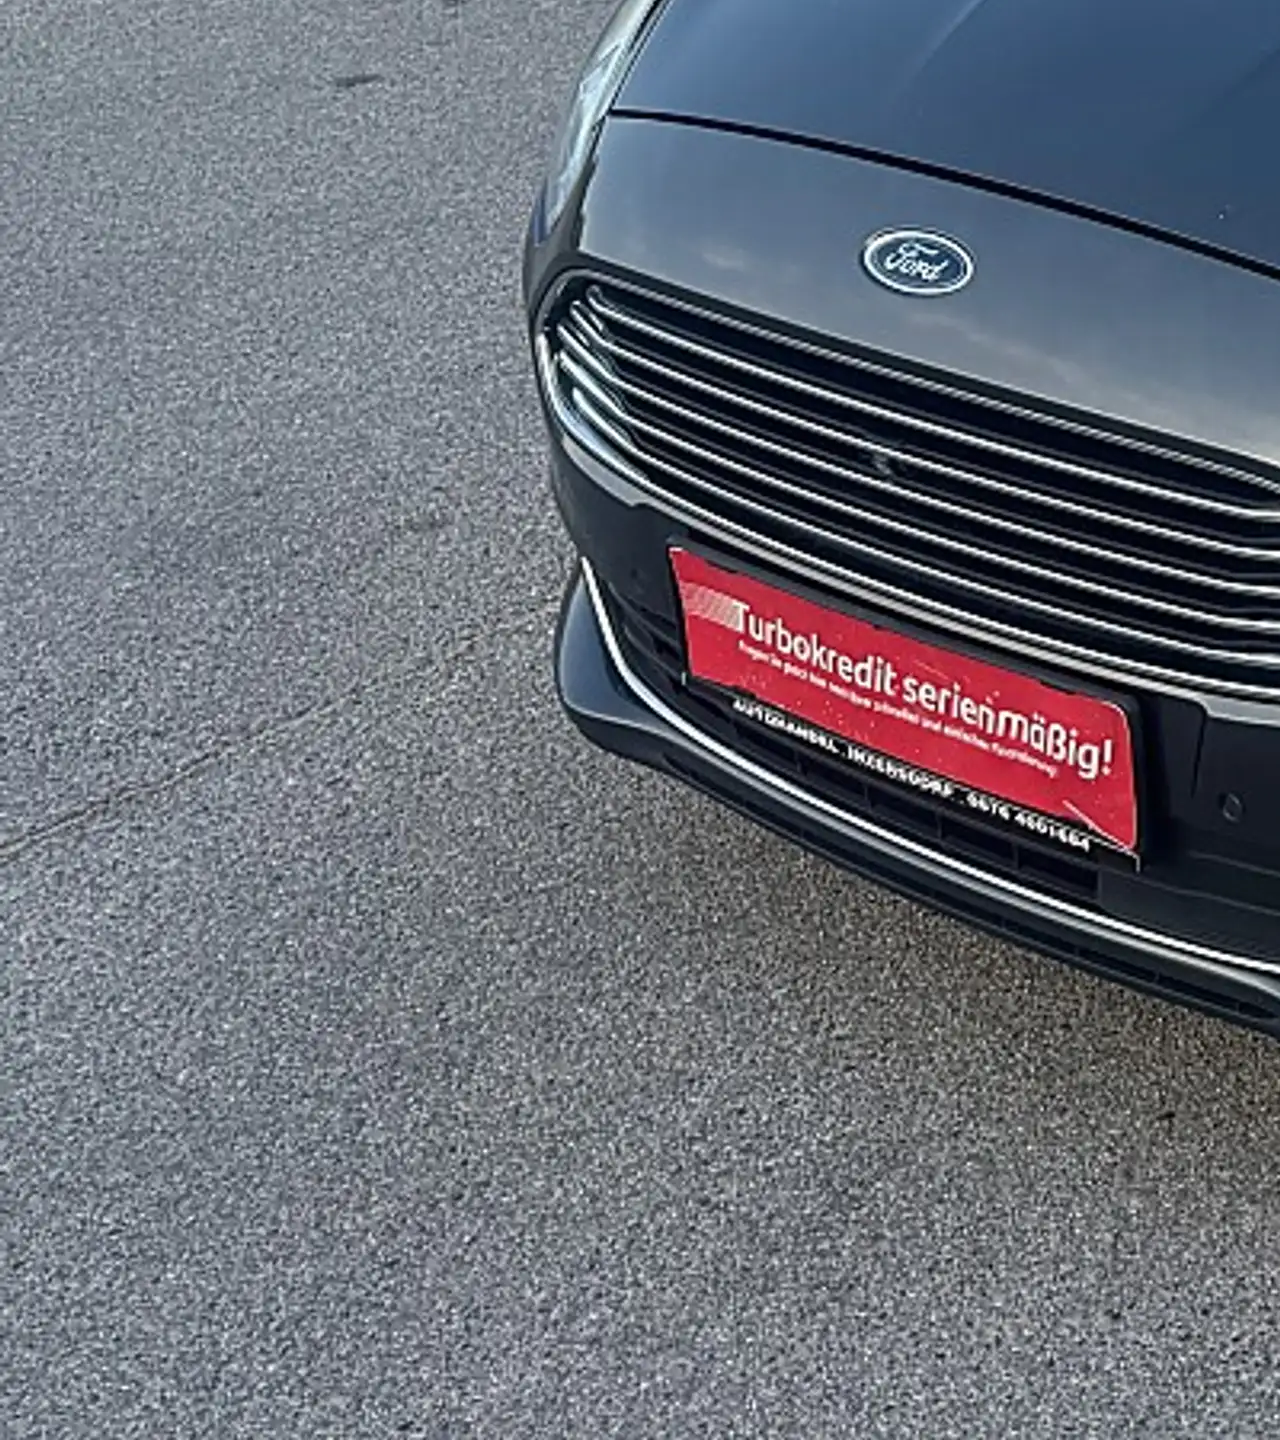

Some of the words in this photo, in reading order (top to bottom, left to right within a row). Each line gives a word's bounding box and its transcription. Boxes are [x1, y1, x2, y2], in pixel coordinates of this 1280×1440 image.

[884, 242, 949, 281] Ford
[734, 603, 898, 696] Turbokredit
[902, 675, 1112, 779] serienmäßig!
